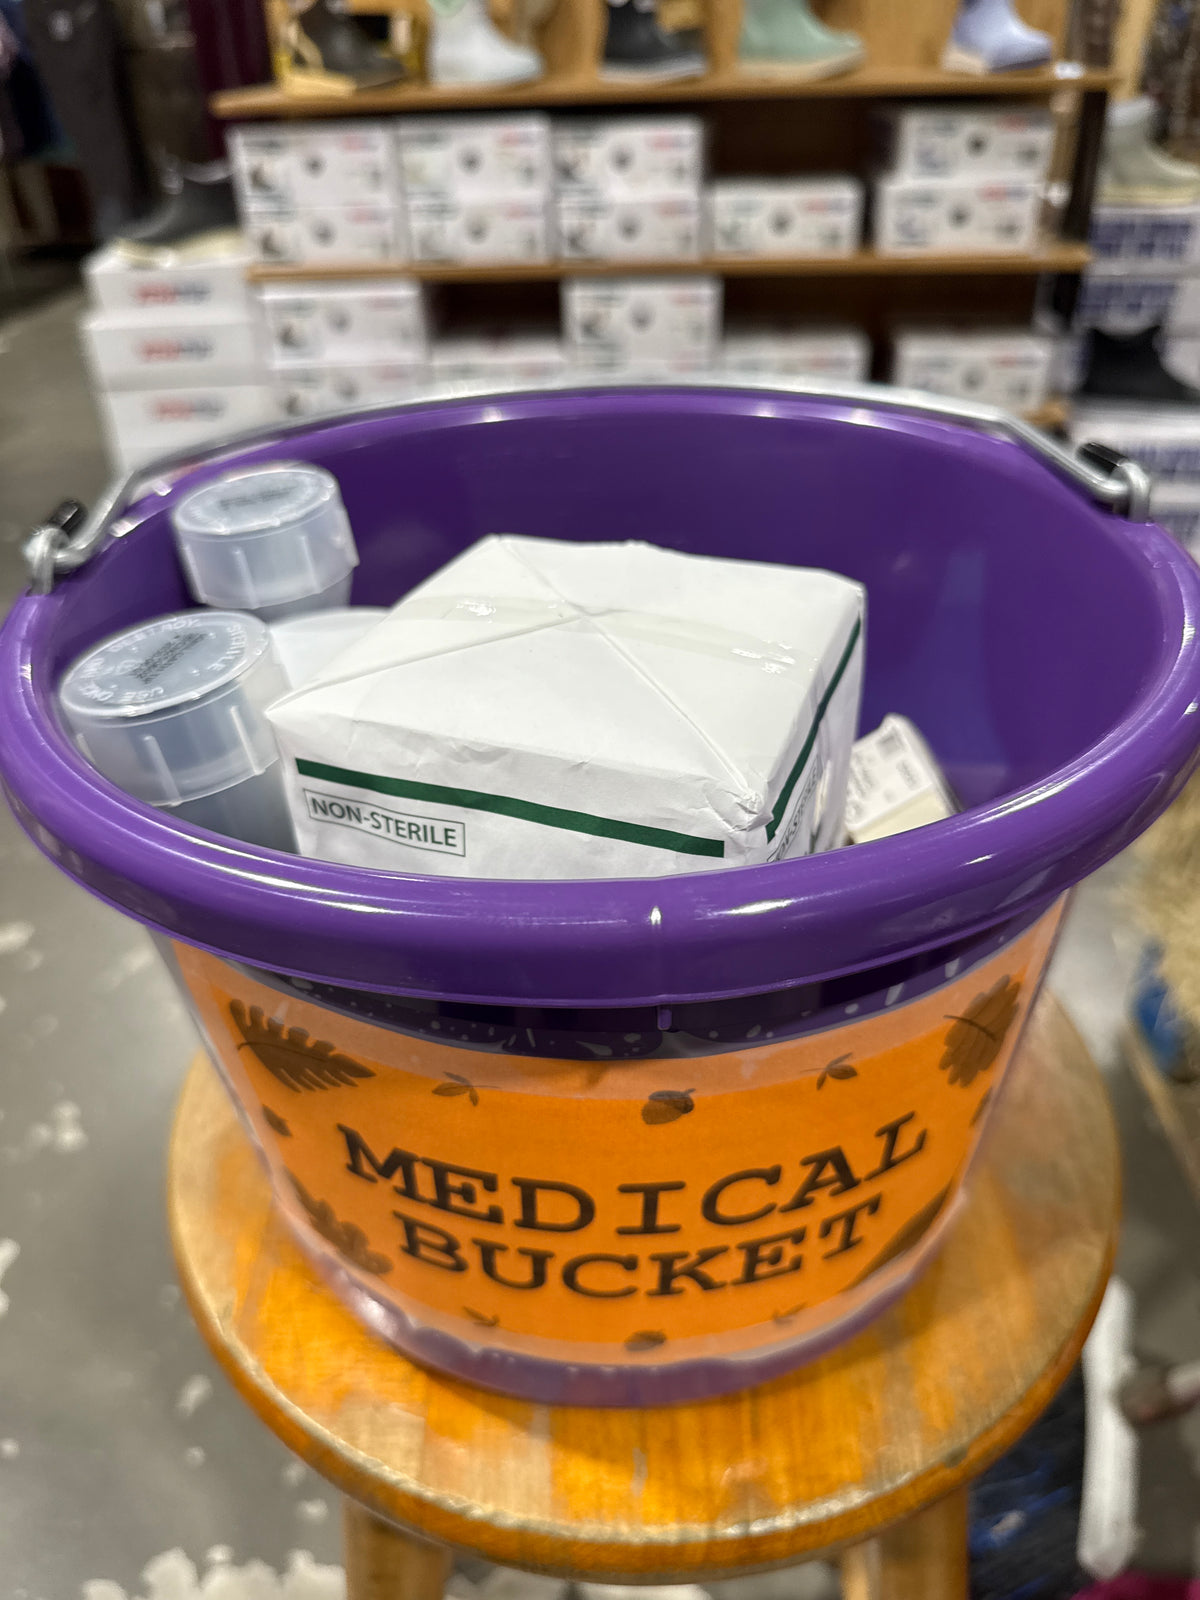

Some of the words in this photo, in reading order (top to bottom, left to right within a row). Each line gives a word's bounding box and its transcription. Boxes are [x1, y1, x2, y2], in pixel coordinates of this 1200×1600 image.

[311, 796, 458, 848] NON-STERILE
[335, 1111, 929, 1236] MEDICAL
[392, 1192, 883, 1298] BUCKET
